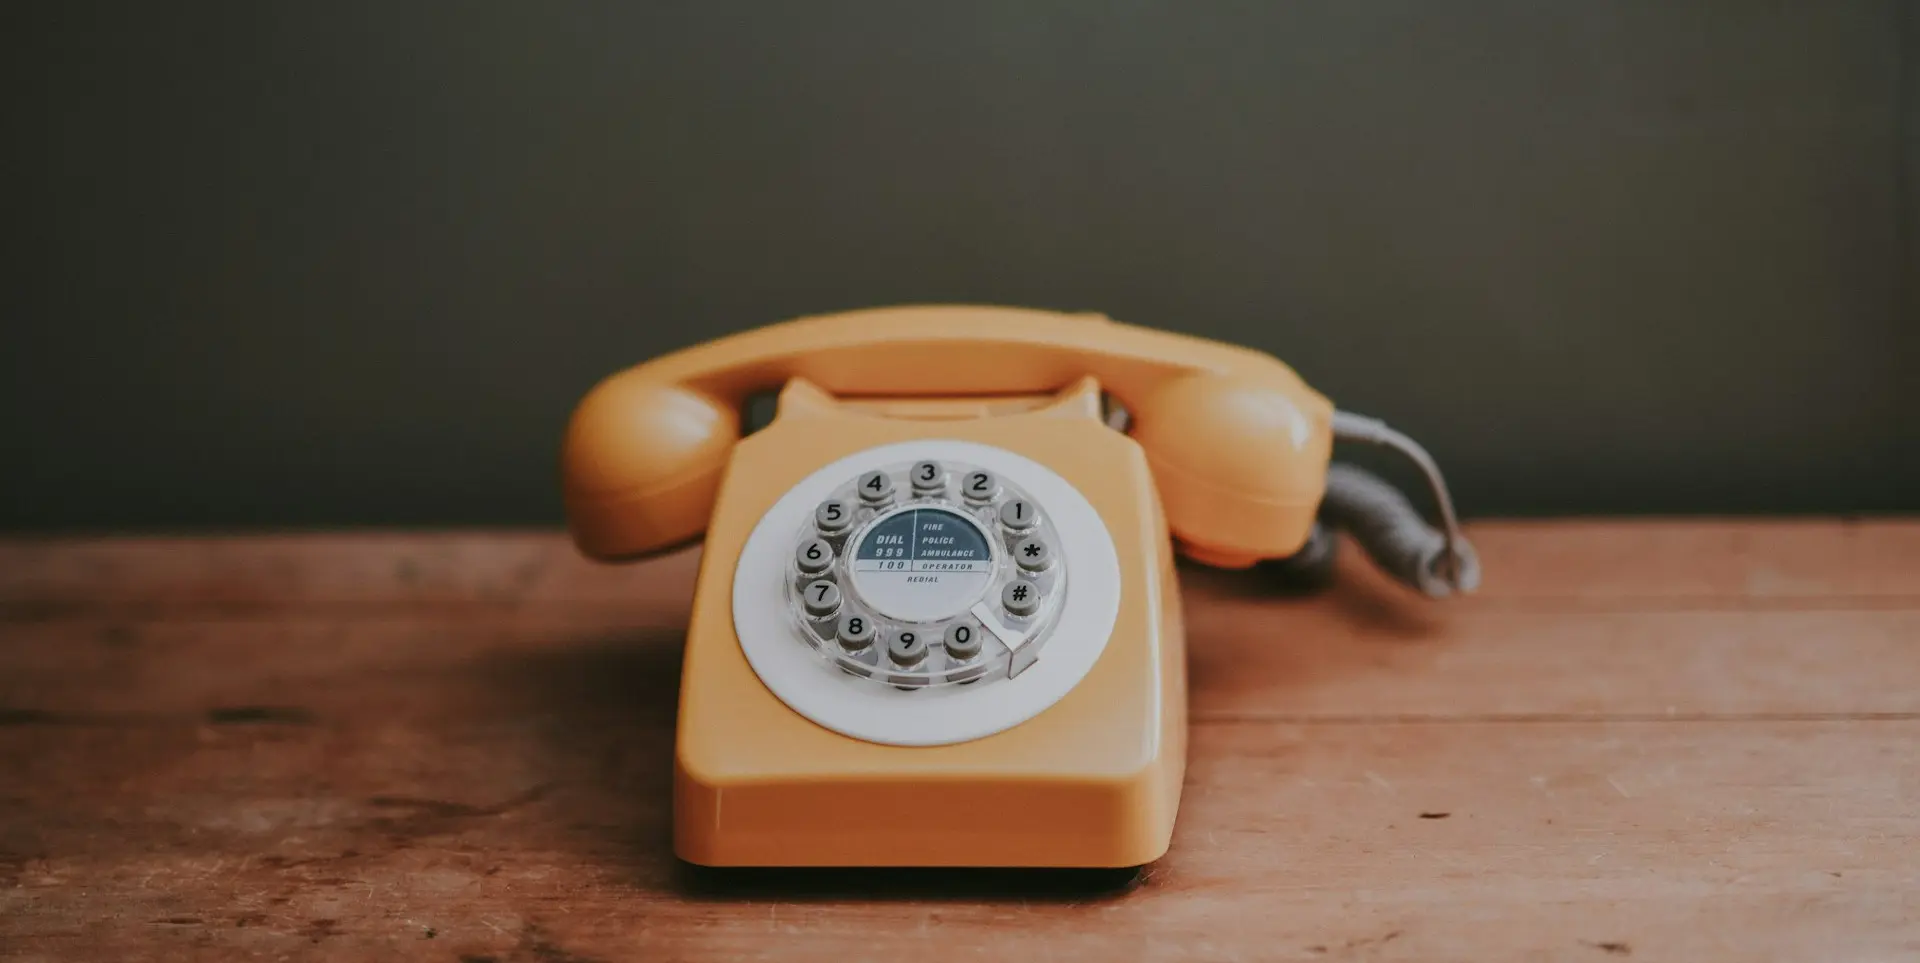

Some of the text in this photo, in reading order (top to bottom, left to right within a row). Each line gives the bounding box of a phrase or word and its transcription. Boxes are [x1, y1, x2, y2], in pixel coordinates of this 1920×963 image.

[921, 464, 935, 480] 3
[867, 476, 881, 491] 4
[973, 474, 987, 490] 2
[828, 504, 841, 520] 5
[1015, 502, 1022, 520] 1
[876, 535, 904, 544] DIAL
[807, 544, 821, 559] 6
[815, 585, 829, 601] 7
[849, 618, 862, 635] 8
[900, 633, 914, 649] 9
[955, 627, 970, 643] 0
